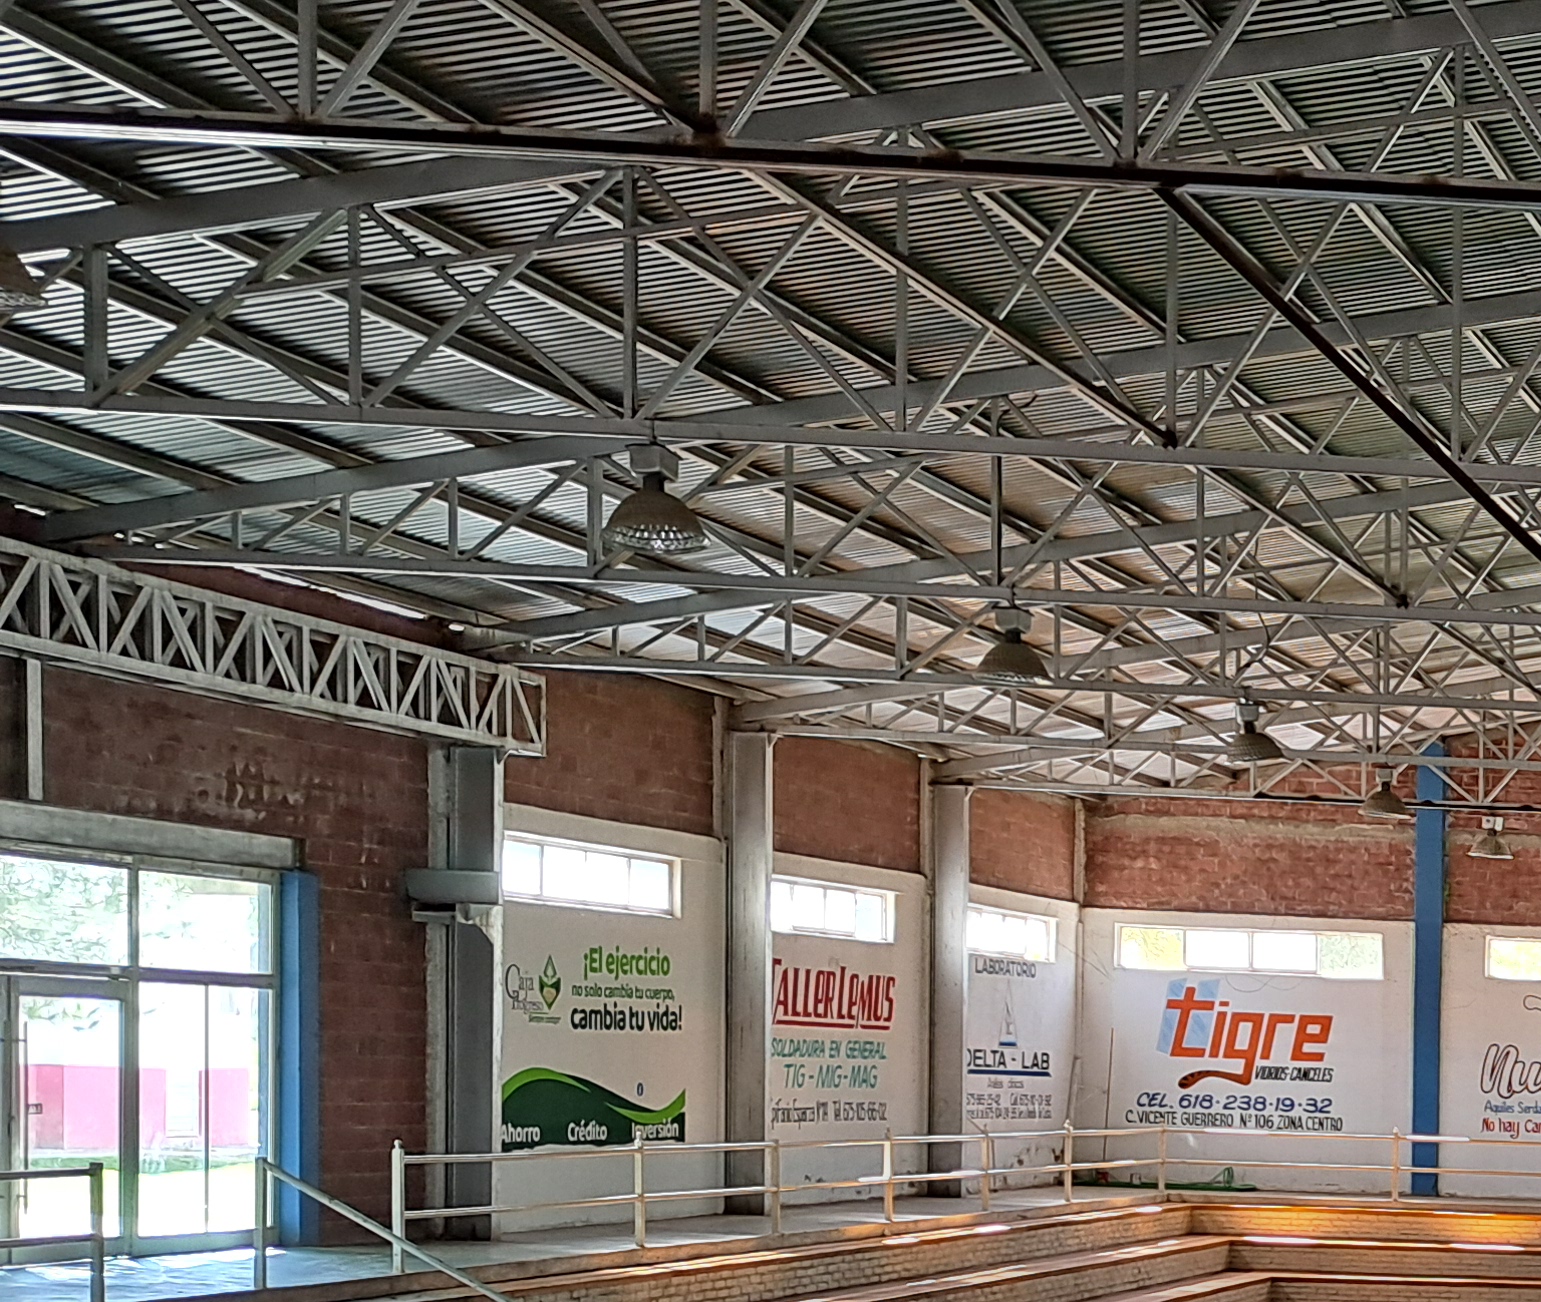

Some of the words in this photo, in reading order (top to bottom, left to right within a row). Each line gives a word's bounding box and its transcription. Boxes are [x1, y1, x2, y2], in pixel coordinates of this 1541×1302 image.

[606, 946, 671, 980] ejercicio
[975, 957, 1036, 978] LABORATORIO
[572, 985, 583, 997] no
[585, 983, 602, 998] solo
[604, 983, 633, 999] cambia
[634, 986, 644, 999] tu
[571, 1001, 626, 1030] cambia
[629, 1005, 645, 1031] tu
[647, 1003, 682, 1031] vida!
[1166, 986, 1334, 1089] tigre
[771, 1037, 825, 1058] SOLDADURA
[846, 1040, 887, 1060] GENERAL
[1021, 1051, 1050, 1070] LAB
[1137, 1092, 1174, 1109] CEL.
[501, 1122, 540, 1142] Ahorro
[567, 1120, 608, 1141] Crédito
[1181, 1112, 1234, 1127] GUERRERO
[1254, 1114, 1274, 1130] 106
[1276, 1115, 1304, 1131] ZONA
[1306, 1117, 1343, 1132] CENTRO
[1481, 1118, 1495, 1132] No
[1499, 1118, 1520, 1139] hay
